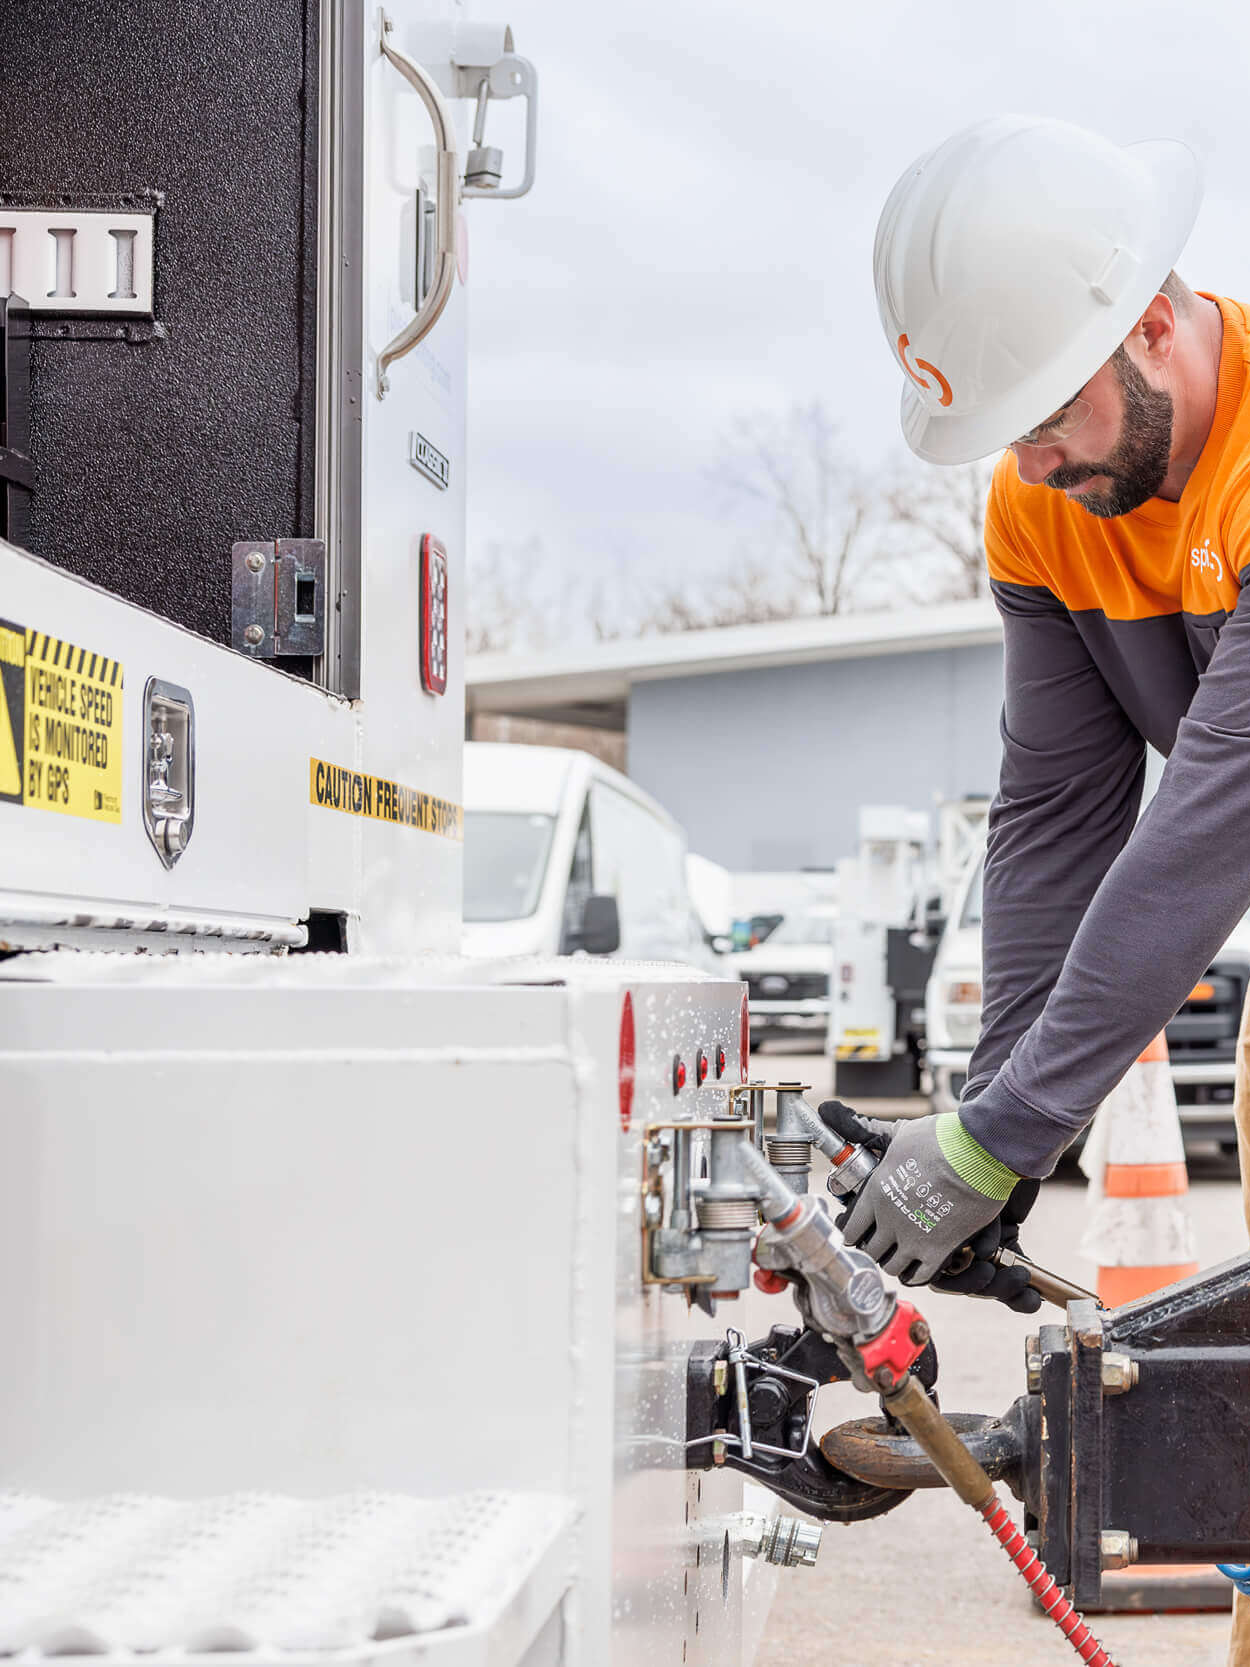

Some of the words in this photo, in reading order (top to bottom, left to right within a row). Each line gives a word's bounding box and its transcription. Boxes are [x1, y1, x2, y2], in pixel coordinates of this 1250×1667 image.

[30, 664, 76, 717] VEHICLE
[80, 683, 113, 729] SPEED
[29, 711, 41, 753] IS
[45, 716, 108, 770] MONITORED
[28, 758, 43, 799] BY
[47, 762, 70, 805] GPS
[316, 761, 372, 815] CAUTION
[376, 779, 428, 830] FREQUENT
[431, 797, 457, 838] STOPS
[914, 1209, 937, 1229] PRO
